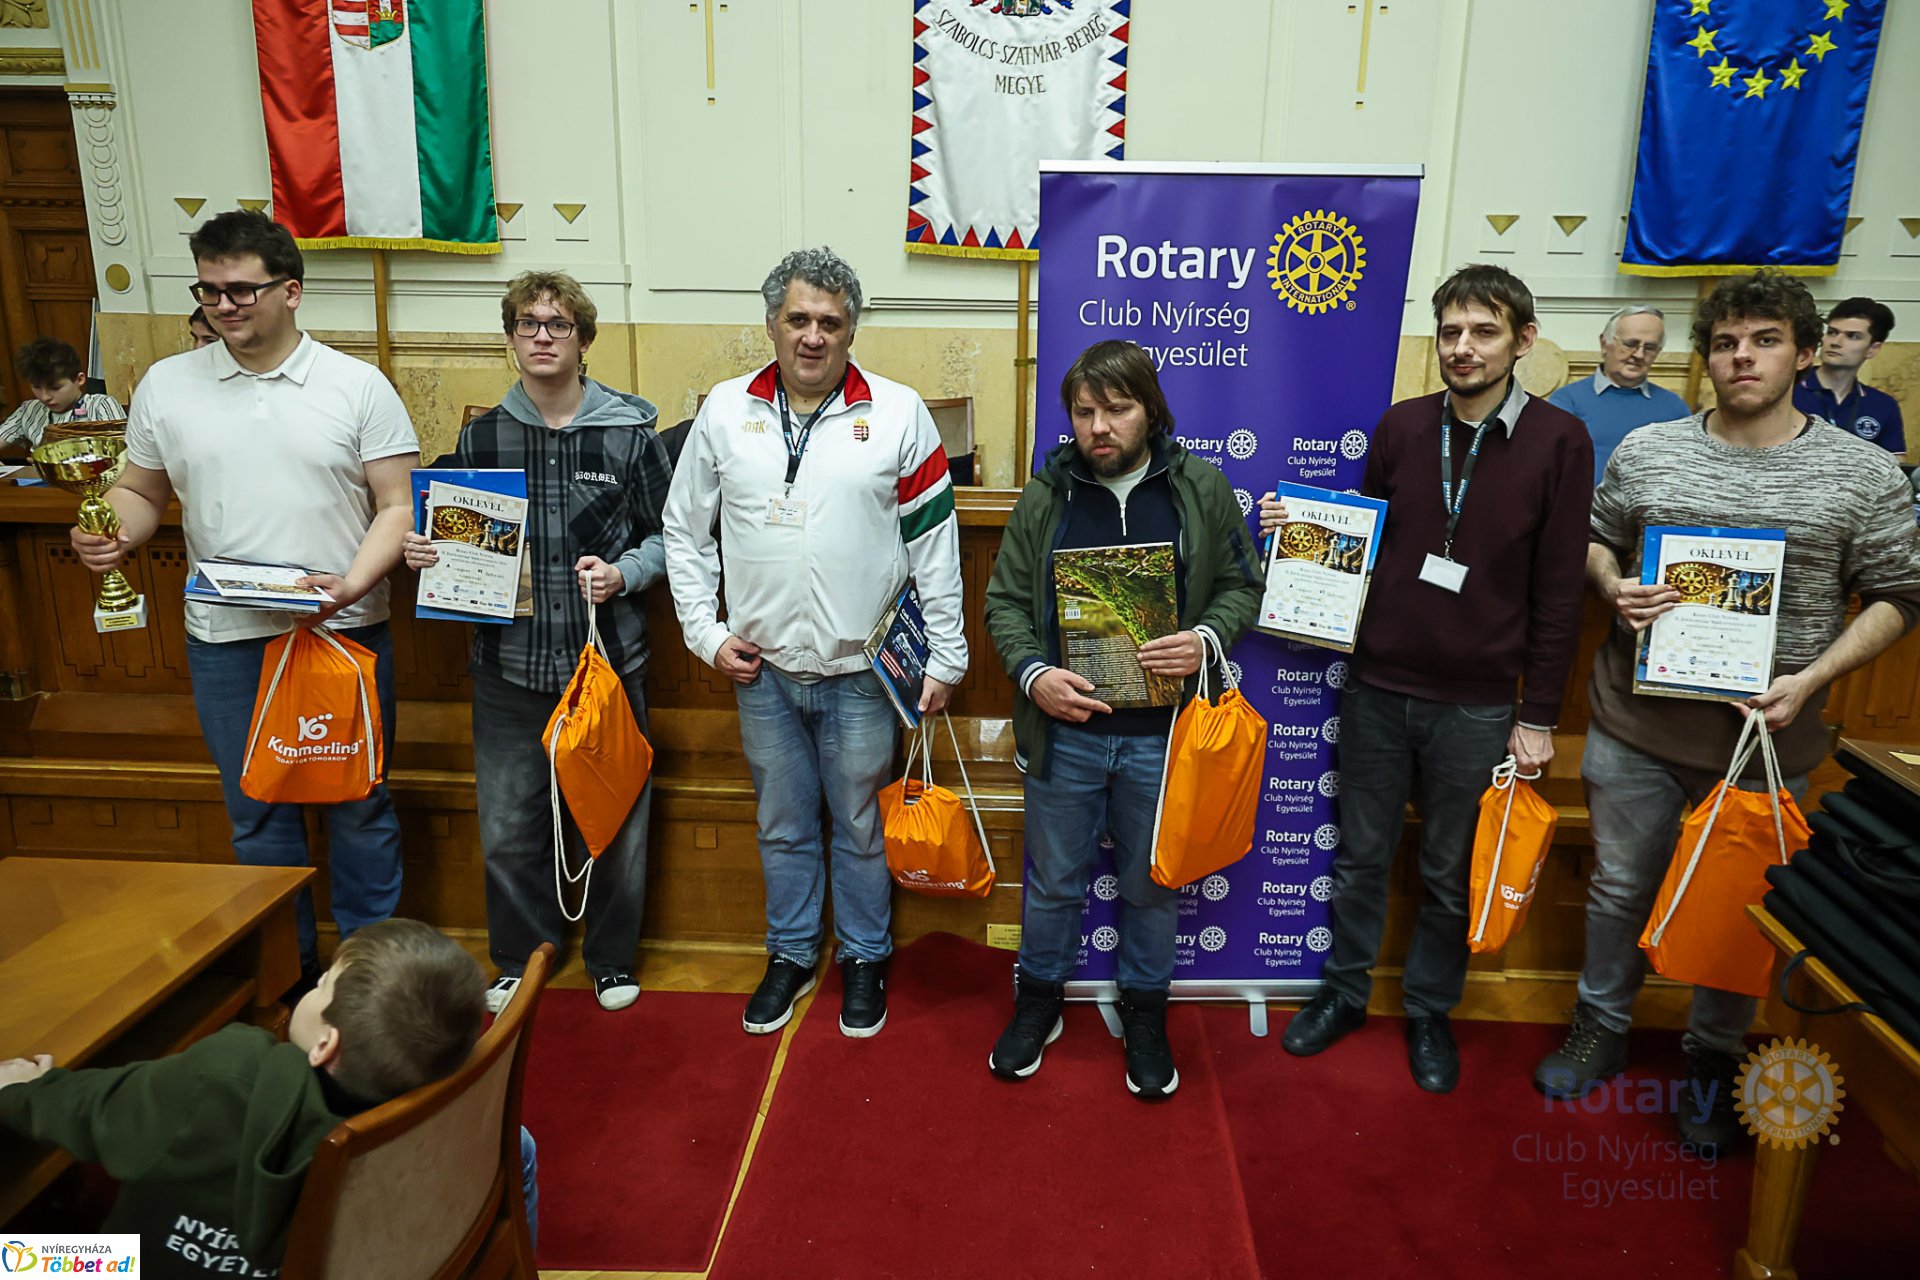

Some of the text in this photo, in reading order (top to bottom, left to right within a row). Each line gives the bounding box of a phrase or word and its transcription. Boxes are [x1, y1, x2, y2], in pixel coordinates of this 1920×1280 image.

[995, 74, 1046, 95] MEGYE
[1298, 220, 1340, 236] ROTARY
[1096, 234, 1256, 289] Rotary
[1280, 277, 1350, 305] INTERNATIONAL
[1079, 300, 1250, 334] Club Nyírség
[1293, 437, 1338, 453] Rotary
[1287, 455, 1337, 468] Club Nyírség
[1300, 467, 1336, 478] Egyesület
[1277, 668, 1323, 684] Rotary
[1271, 685, 1321, 696] Club Nyírség
[1284, 697, 1321, 707] Egyesület
[1273, 723, 1319, 738] Rotary
[1267, 740, 1318, 750] Club Nyírség
[1280, 751, 1317, 761] Egyesület
[1269, 777, 1315, 792] Rotary
[1264, 793, 1314, 804] Club Nyírség
[1276, 804, 1313, 814] Egyesület
[1266, 829, 1312, 845] Rotary
[1260, 846, 1310, 856] Club Nyírség
[1272, 856, 1309, 866] Egyesület
[1262, 881, 1308, 896] Rotary
[1257, 897, 1306, 907] Club Nyírség
[1269, 907, 1305, 917] Egyesület
[1259, 932, 1304, 947] Rotary
[1253, 948, 1302, 958] Club Nyírség
[1265, 958, 1301, 968] Egyesület
